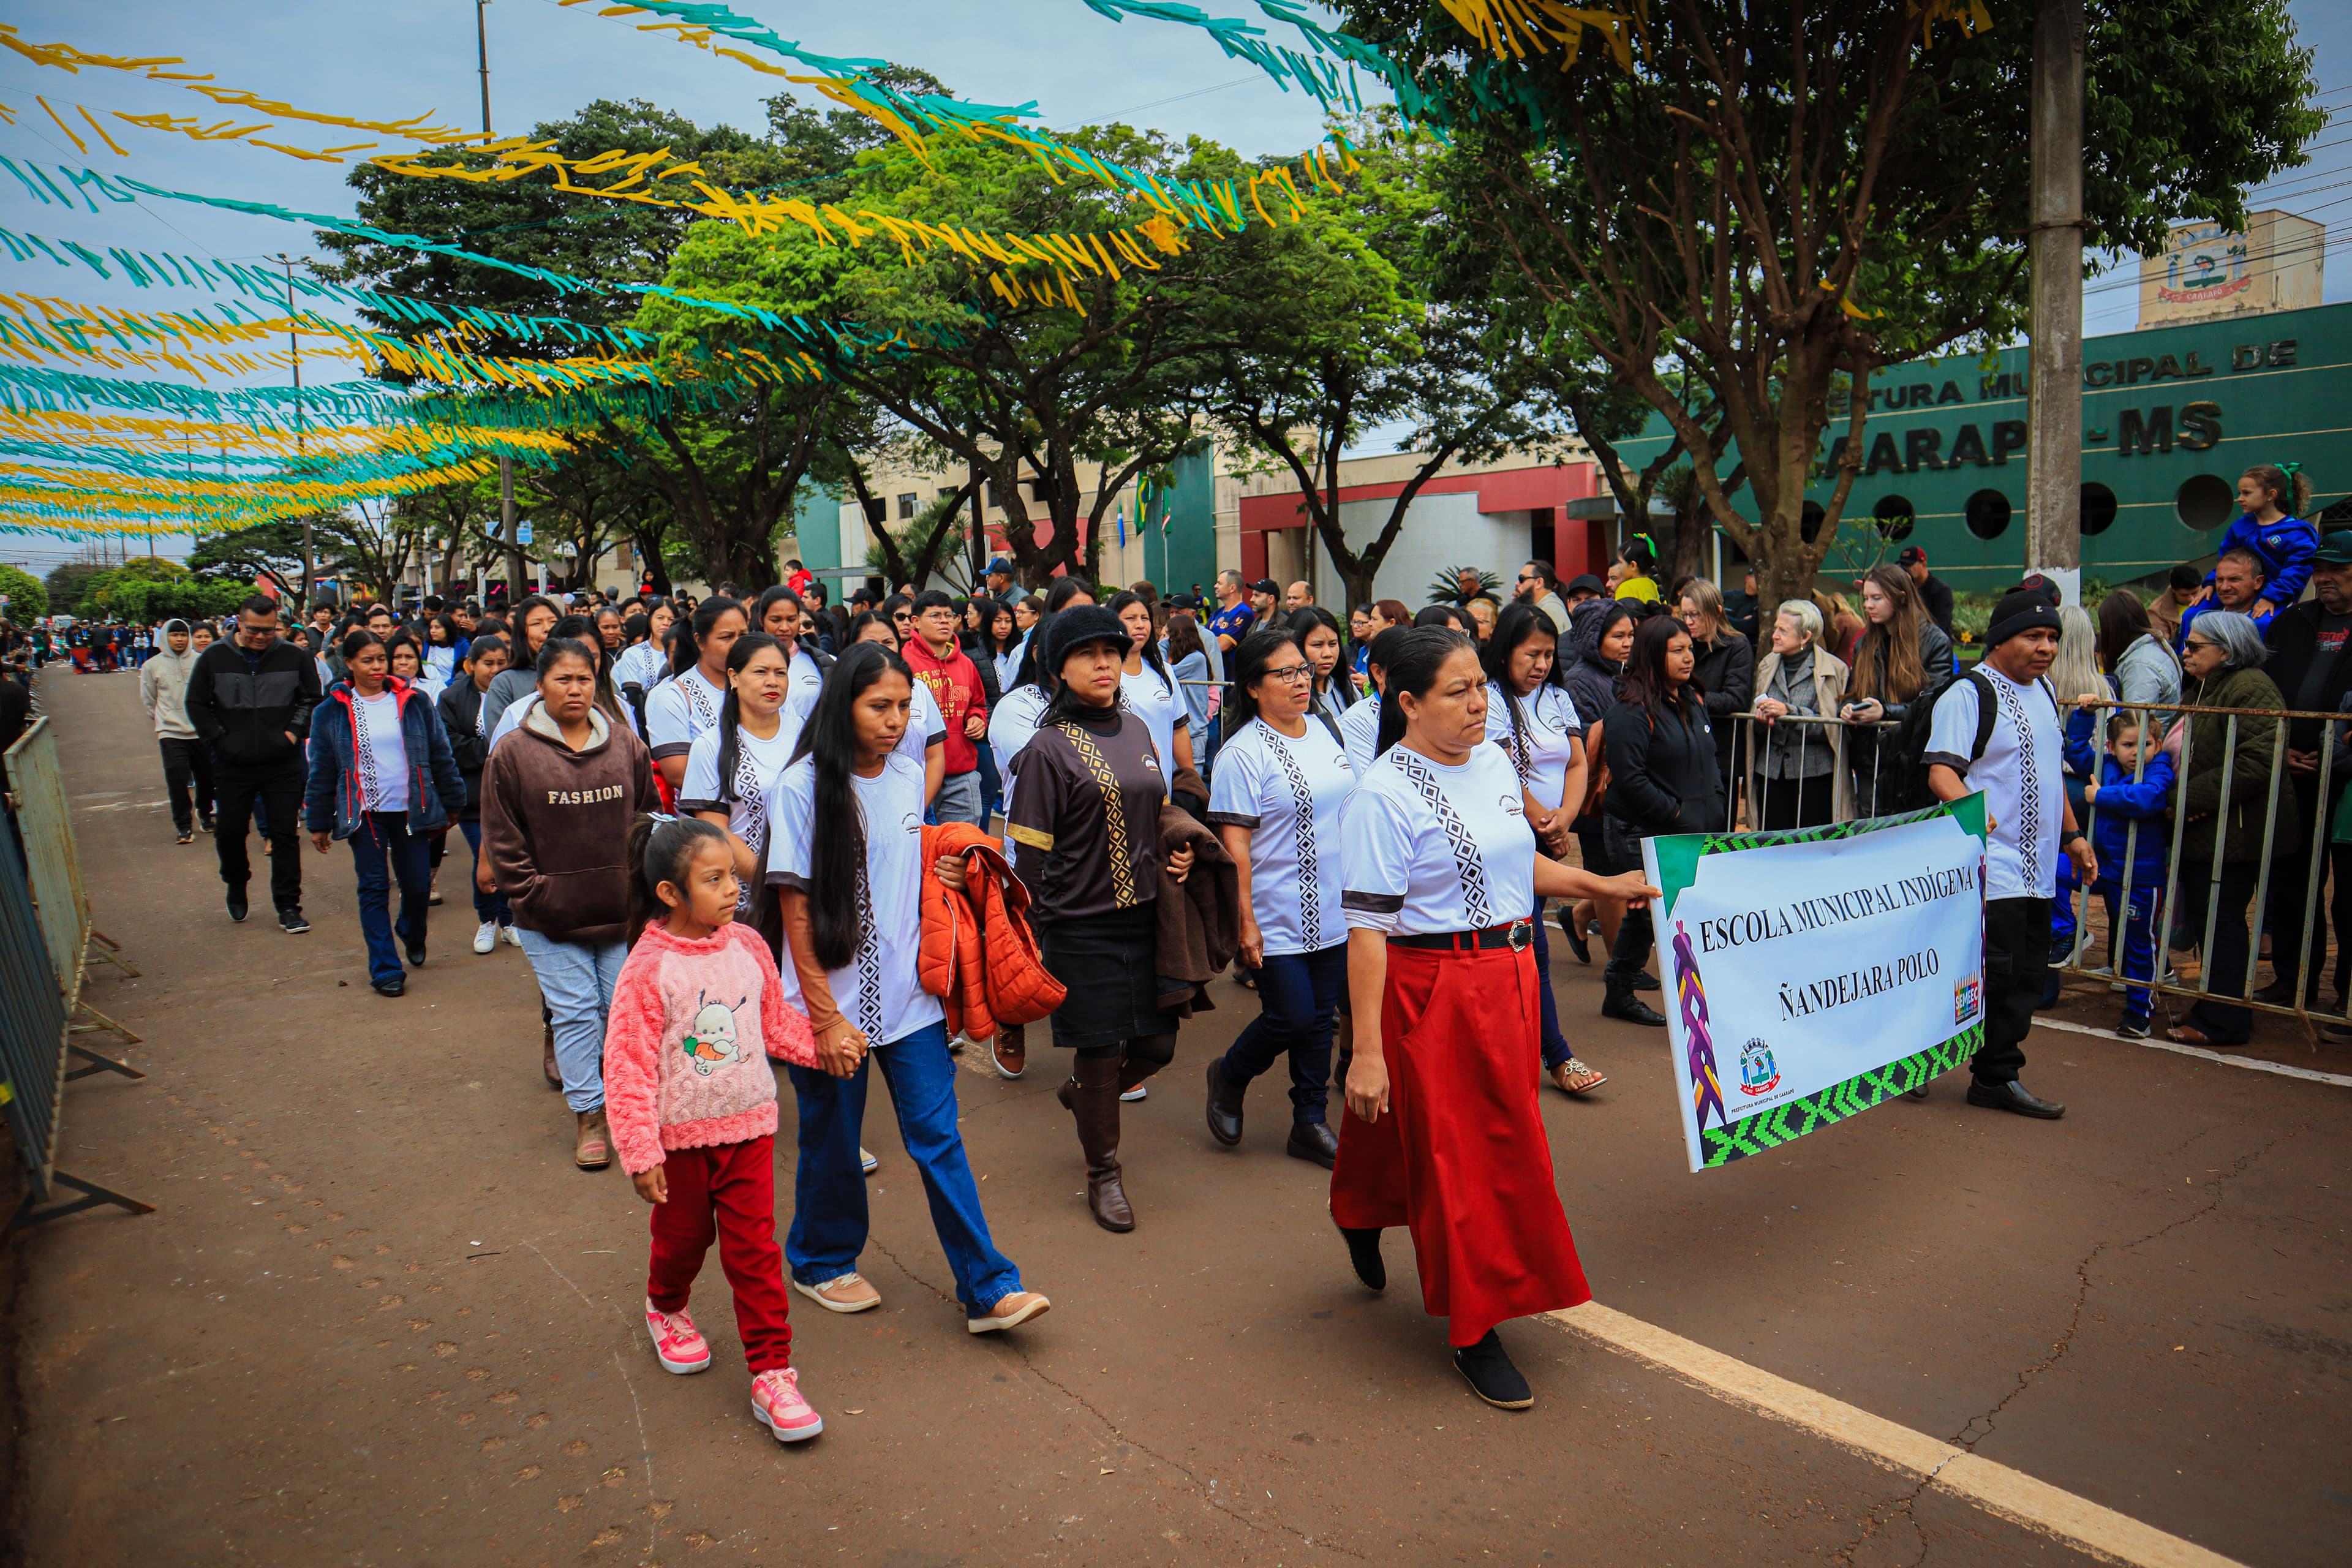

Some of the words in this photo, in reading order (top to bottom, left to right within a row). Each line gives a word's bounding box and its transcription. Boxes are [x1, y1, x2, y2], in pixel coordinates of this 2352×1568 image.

[1980, 351, 2214, 399] MUCIPAL
[2233, 339, 2297, 371] DE
[548, 785, 623, 804] FASHION
[1698, 907, 1793, 953] ESCOLA
[1790, 884, 1901, 932] MUNICIPAL
[1897, 865, 1974, 907] INDÍGENA
[1778, 962, 1894, 1022] ÑANDEJARA
[1898, 948, 1939, 986] POLO
[1956, 986, 1978, 1010] SEMEEC
[1731, 1103, 1754, 1114] PREFEITURA
[1754, 1096, 1773, 1106] MUNICIPAL
